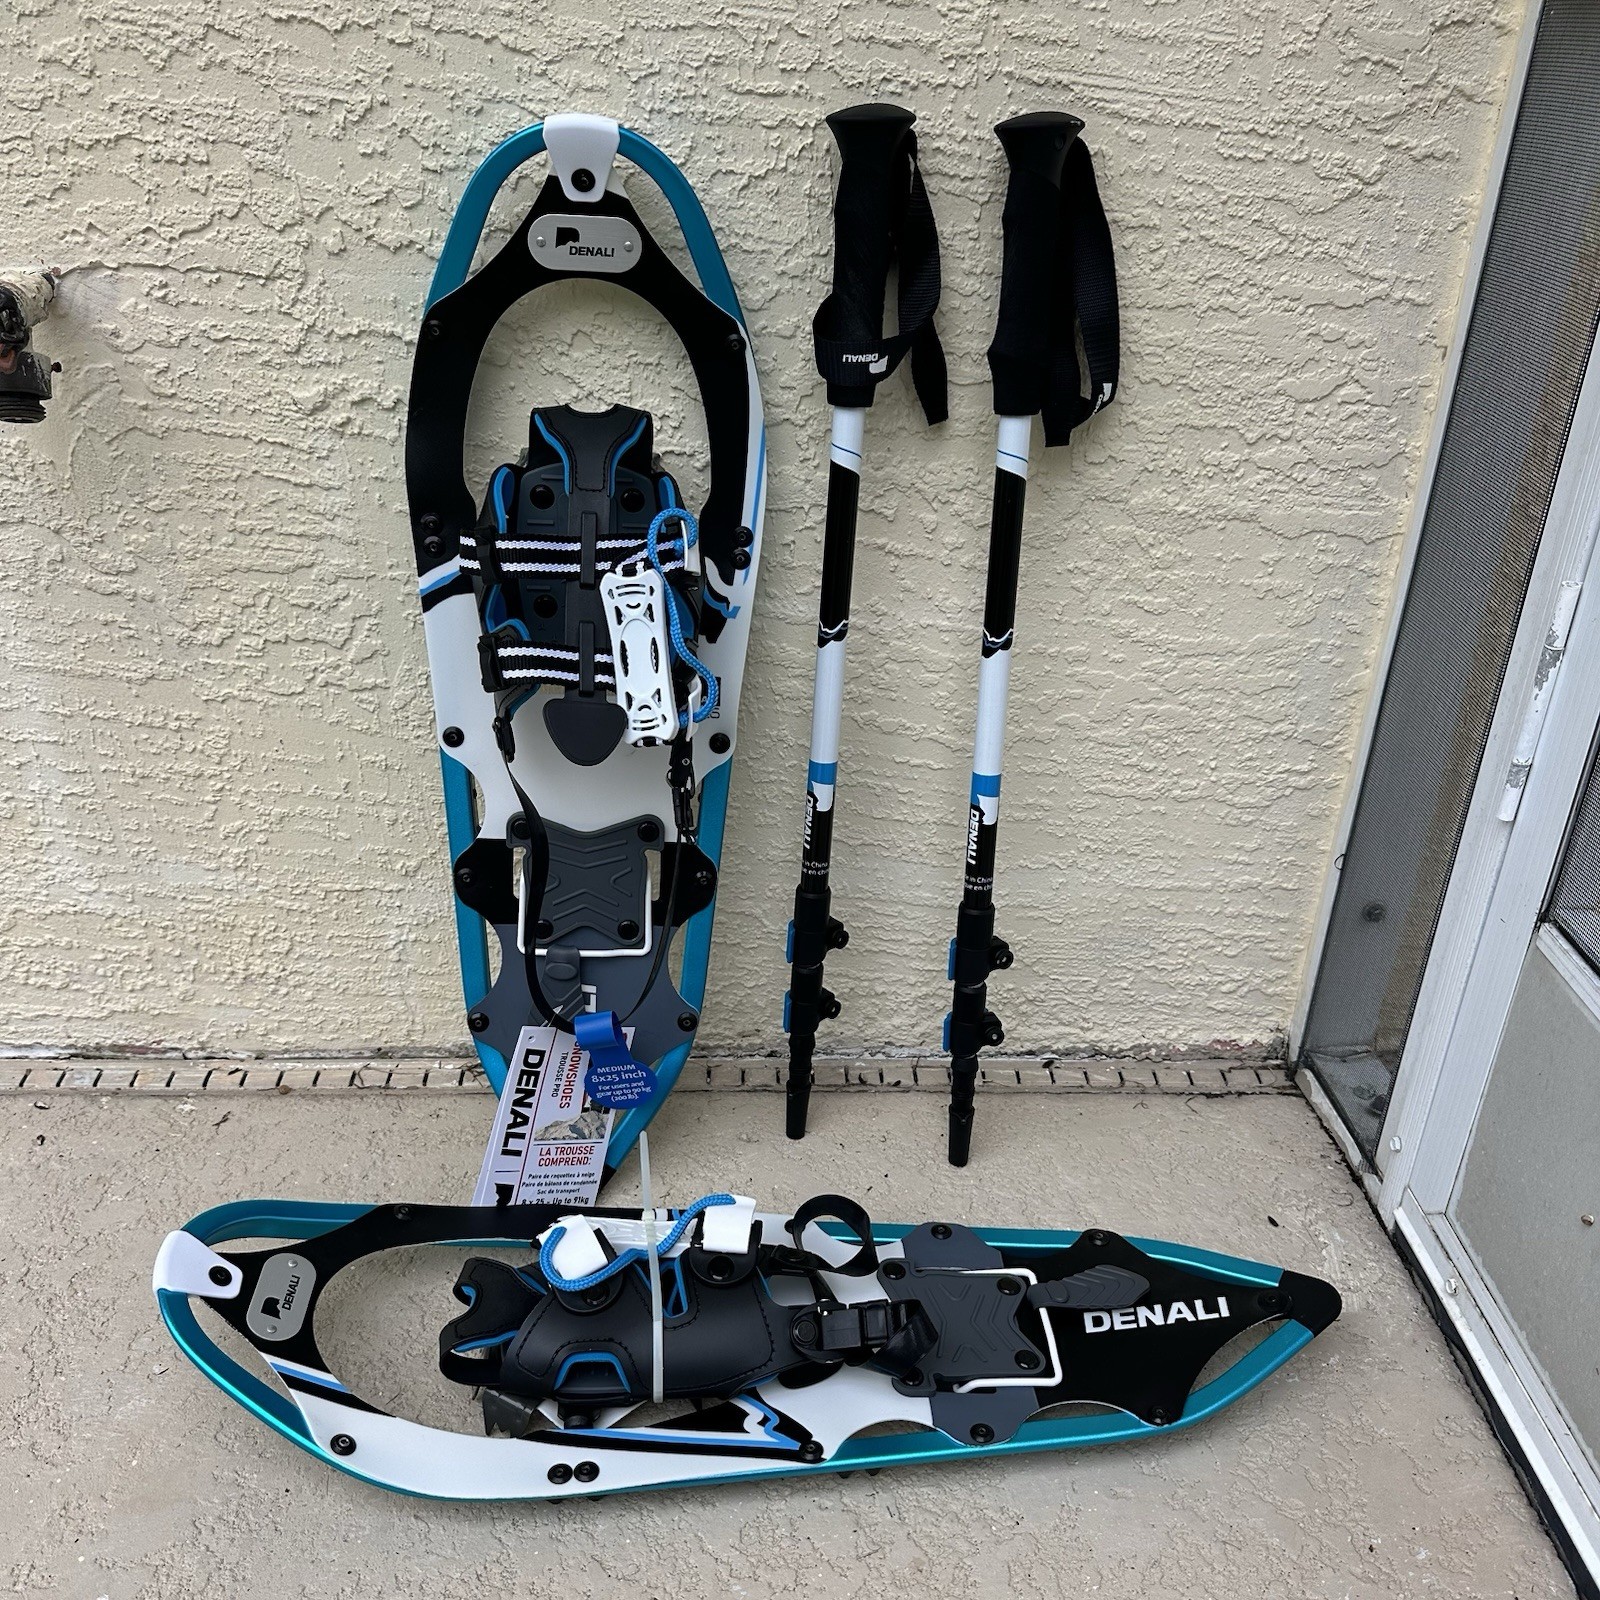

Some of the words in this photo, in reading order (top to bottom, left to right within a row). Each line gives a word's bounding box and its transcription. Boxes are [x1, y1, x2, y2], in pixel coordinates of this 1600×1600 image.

[569, 246, 614, 257] DENALI
[842, 353, 879, 363] DENALI
[804, 794, 814, 849] DENALI
[967, 809, 980, 865] DENALI
[555, 1052, 569, 1082] TROUSSE
[597, 1064, 636, 1074] MEDIUM
[591, 1074, 620, 1083] 8x25
[621, 1070, 647, 1080] inch
[551, 1084, 561, 1098] PRO
[596, 1091, 612, 1099] gear
[500, 1048, 547, 1157] DENALI
[539, 1148, 551, 1156] LA
[555, 1146, 595, 1156] TROUSSE
[538, 1157, 592, 1167] COMPREND:
[551, 1172, 575, 1180] raquettes
[555, 1187, 580, 1195] transport
[552, 1197, 562, 1205] Up
[573, 1196, 590, 1205] 91kg
[281, 1274, 301, 1311] DENALI
[1083, 1296, 1230, 1334] DENALI
